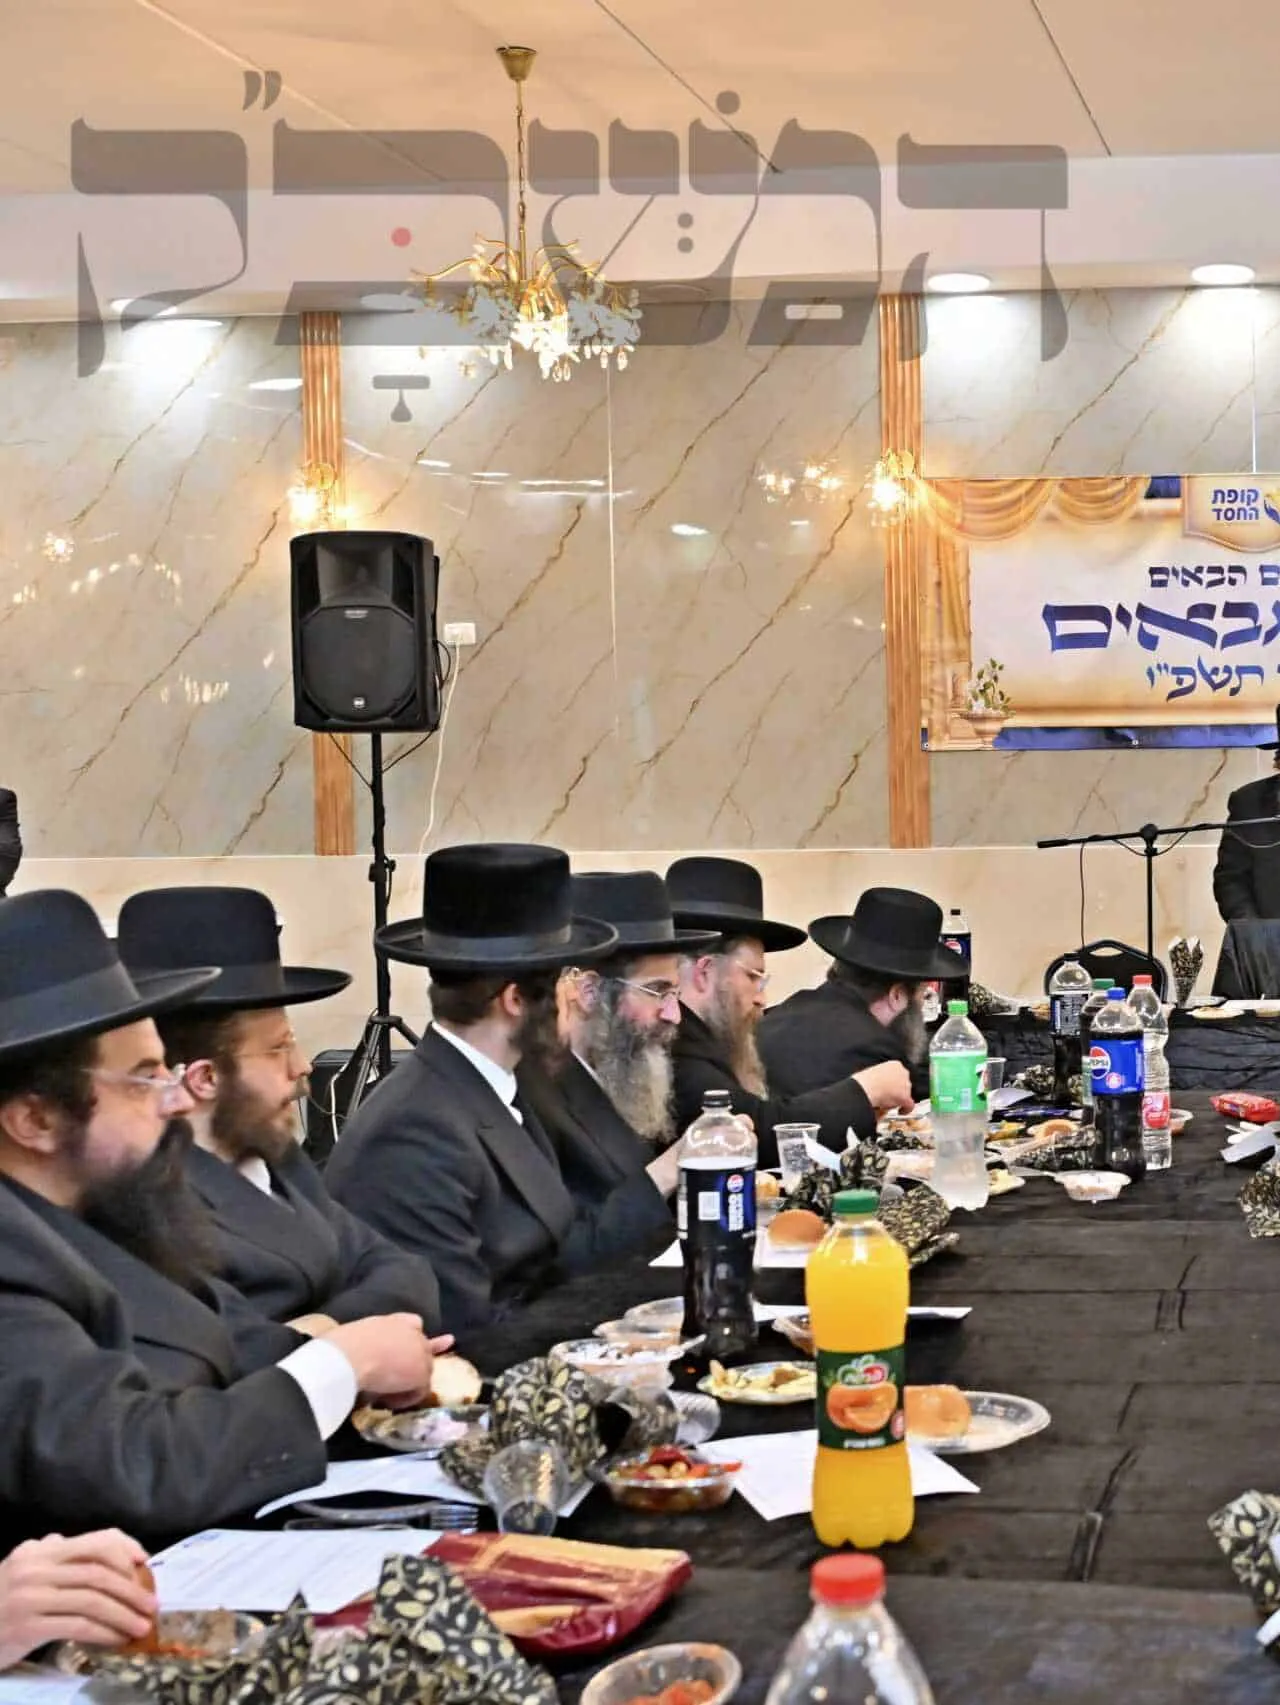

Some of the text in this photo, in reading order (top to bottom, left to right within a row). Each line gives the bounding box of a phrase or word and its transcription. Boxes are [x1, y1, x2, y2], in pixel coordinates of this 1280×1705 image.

[1211, 488, 1259, 506] קופת
[1211, 507, 1259, 521] החסד
[1148, 565, 1247, 589] הבאים
